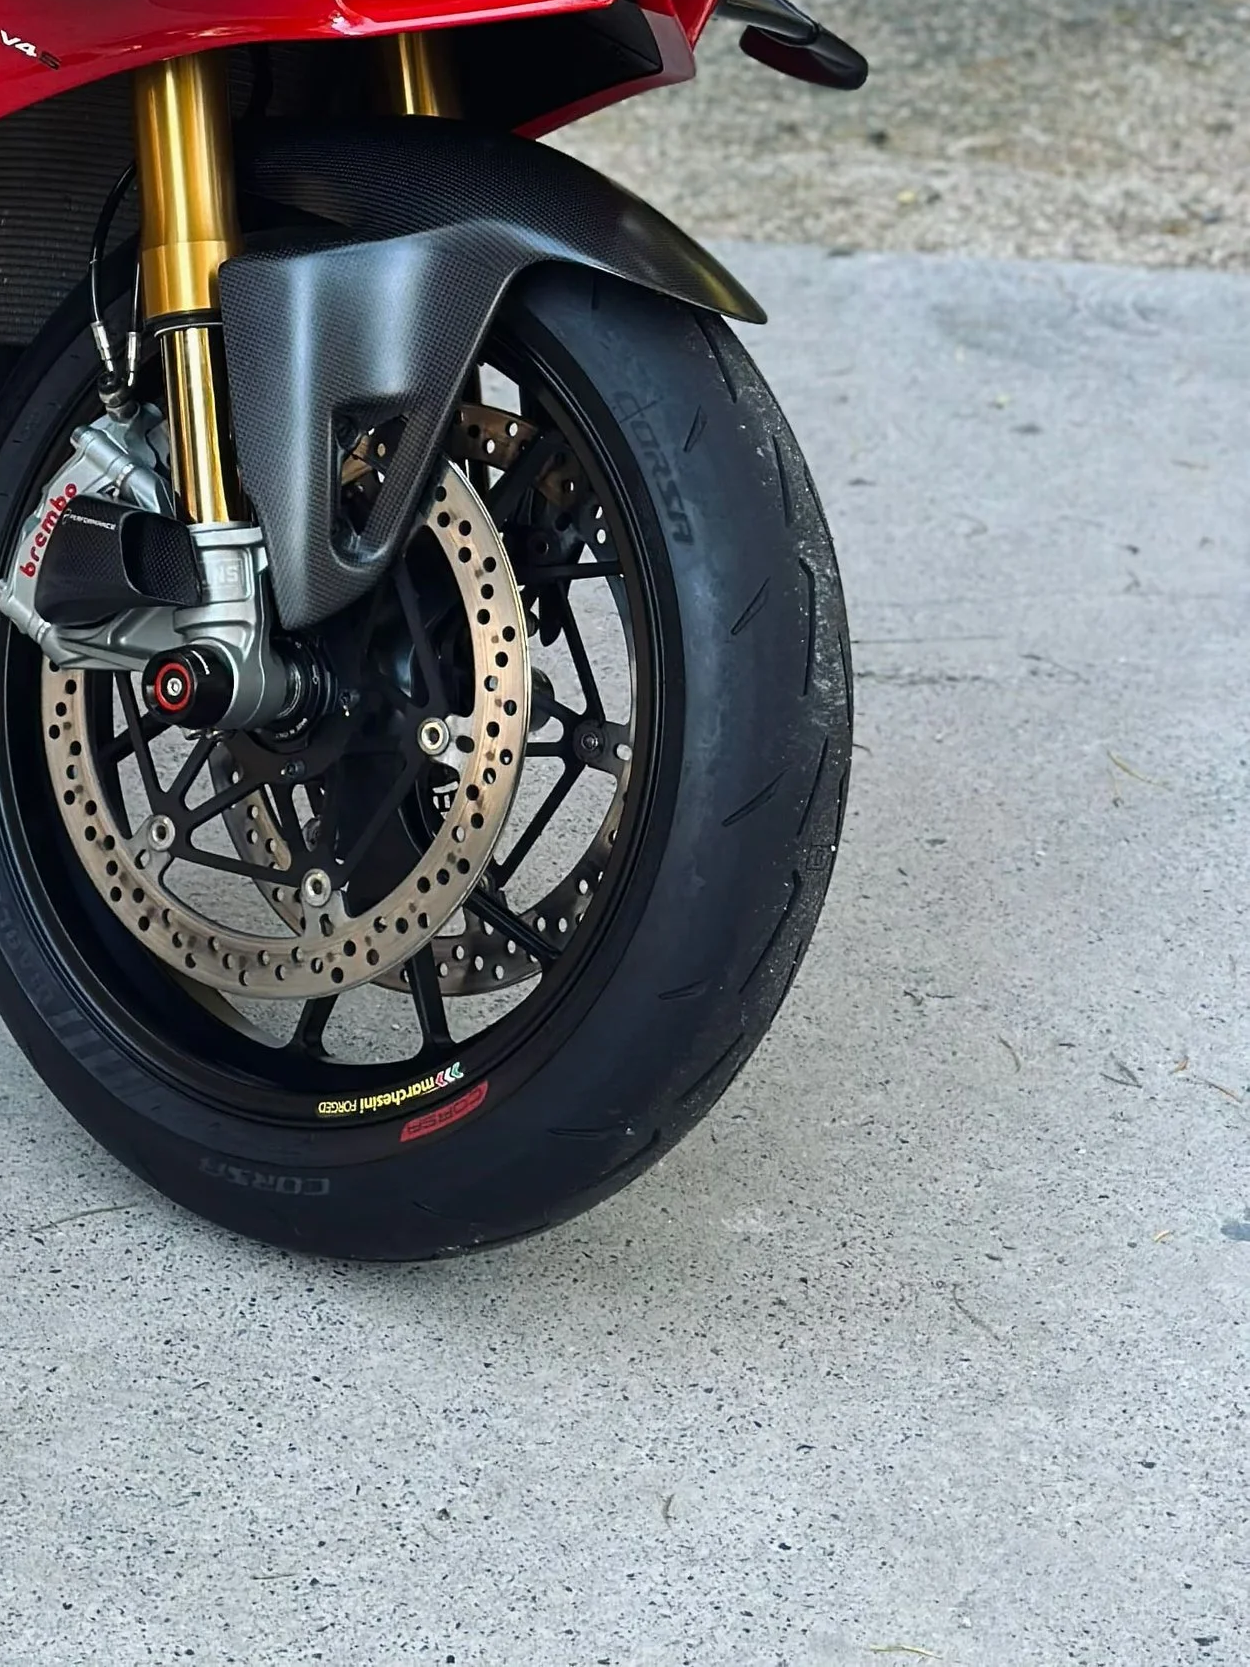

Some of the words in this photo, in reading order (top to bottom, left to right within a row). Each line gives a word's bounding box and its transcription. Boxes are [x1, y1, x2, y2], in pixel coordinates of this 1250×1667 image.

[19, 483, 77, 577] brembo
[318, 1100, 357, 1114] FORGED
[360, 1076, 435, 1114] marchesini
